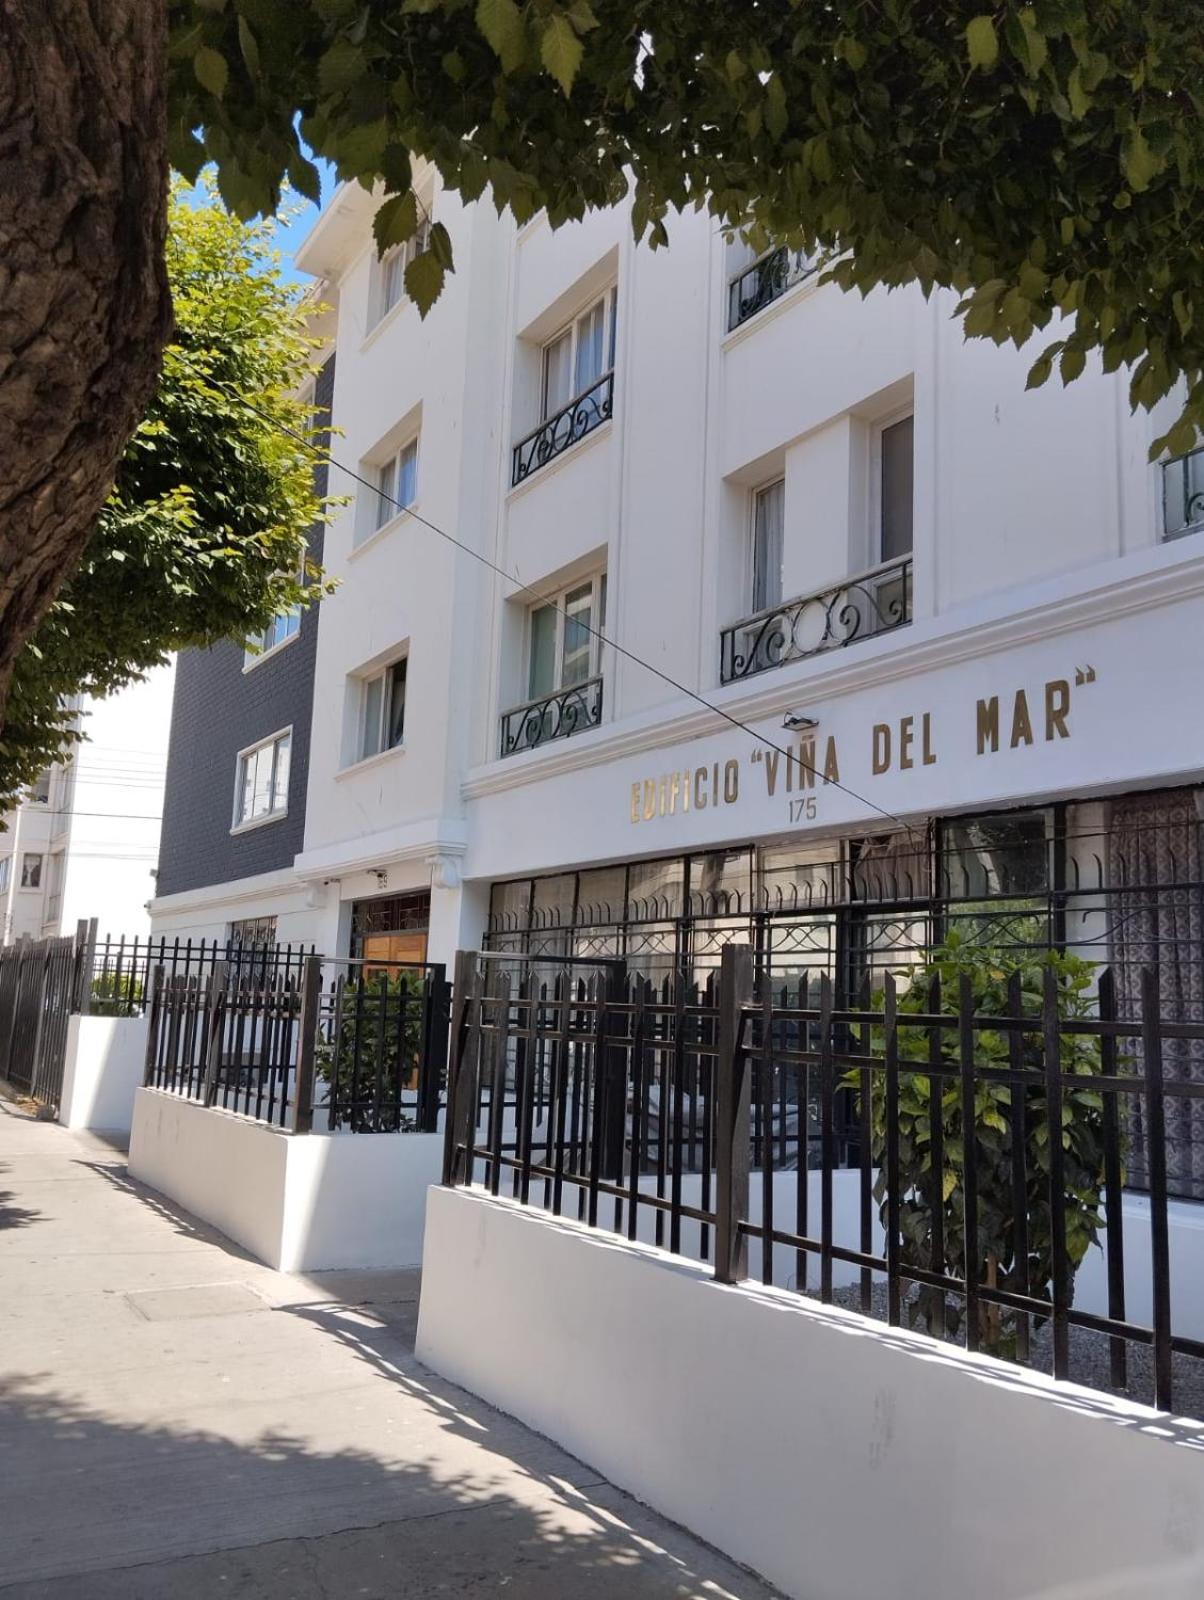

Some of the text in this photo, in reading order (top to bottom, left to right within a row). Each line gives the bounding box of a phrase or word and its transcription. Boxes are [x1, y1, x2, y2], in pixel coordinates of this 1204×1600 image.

[630, 759, 739, 824] EDIFICIO
[872, 712, 936, 775] DEL
[789, 797, 817, 823] 175
